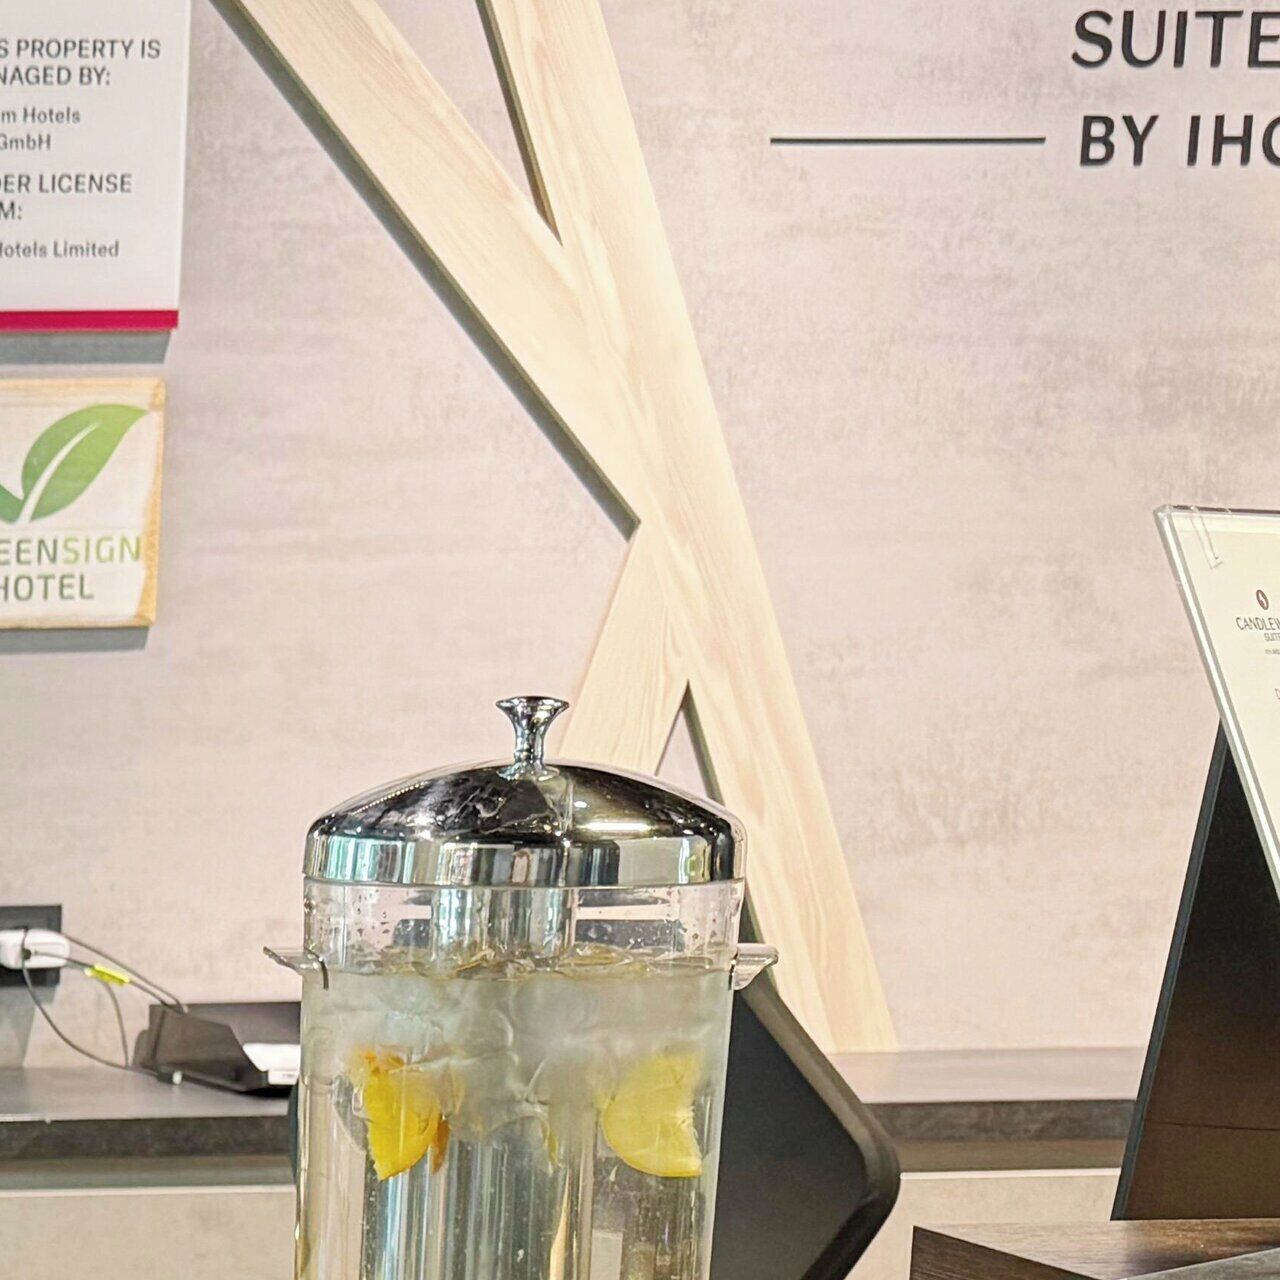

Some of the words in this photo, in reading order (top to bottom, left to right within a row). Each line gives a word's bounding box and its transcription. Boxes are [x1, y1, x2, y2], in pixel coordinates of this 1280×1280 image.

[15, 38, 135, 59] PROPERTY
[140, 39, 162, 60] IS
[78, 66, 111, 86] BY:
[22, 106, 81, 124] Hotels
[1079, 114, 1159, 167] BY
[38, 173, 133, 194] LICENSE
[52, 240, 120, 258] Limited
